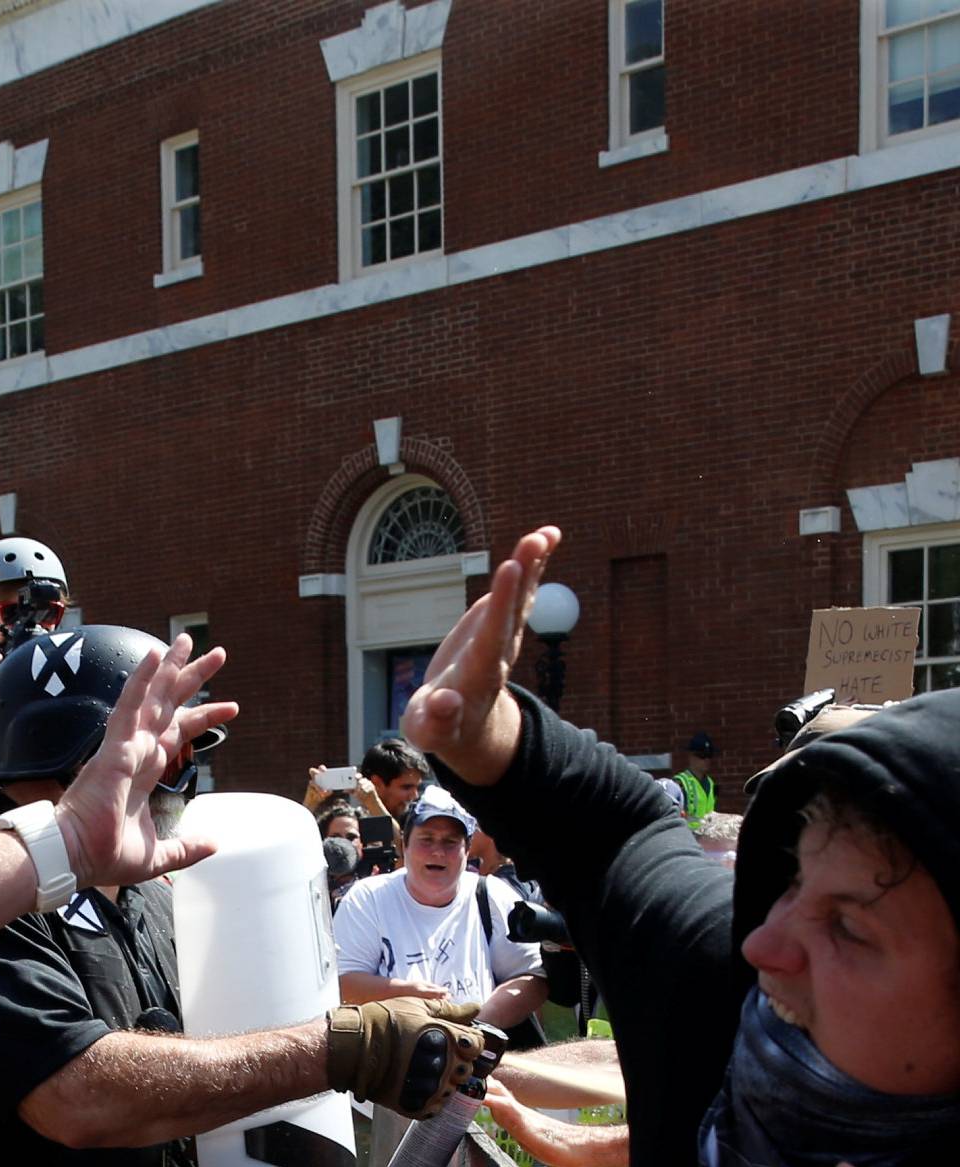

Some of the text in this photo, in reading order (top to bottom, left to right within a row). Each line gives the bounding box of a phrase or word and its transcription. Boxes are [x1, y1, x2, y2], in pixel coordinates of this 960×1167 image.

[820, 619, 913, 647] NO WHITE
[824, 650, 912, 667] SUPREMECIST
[840, 675, 883, 694] HATE
